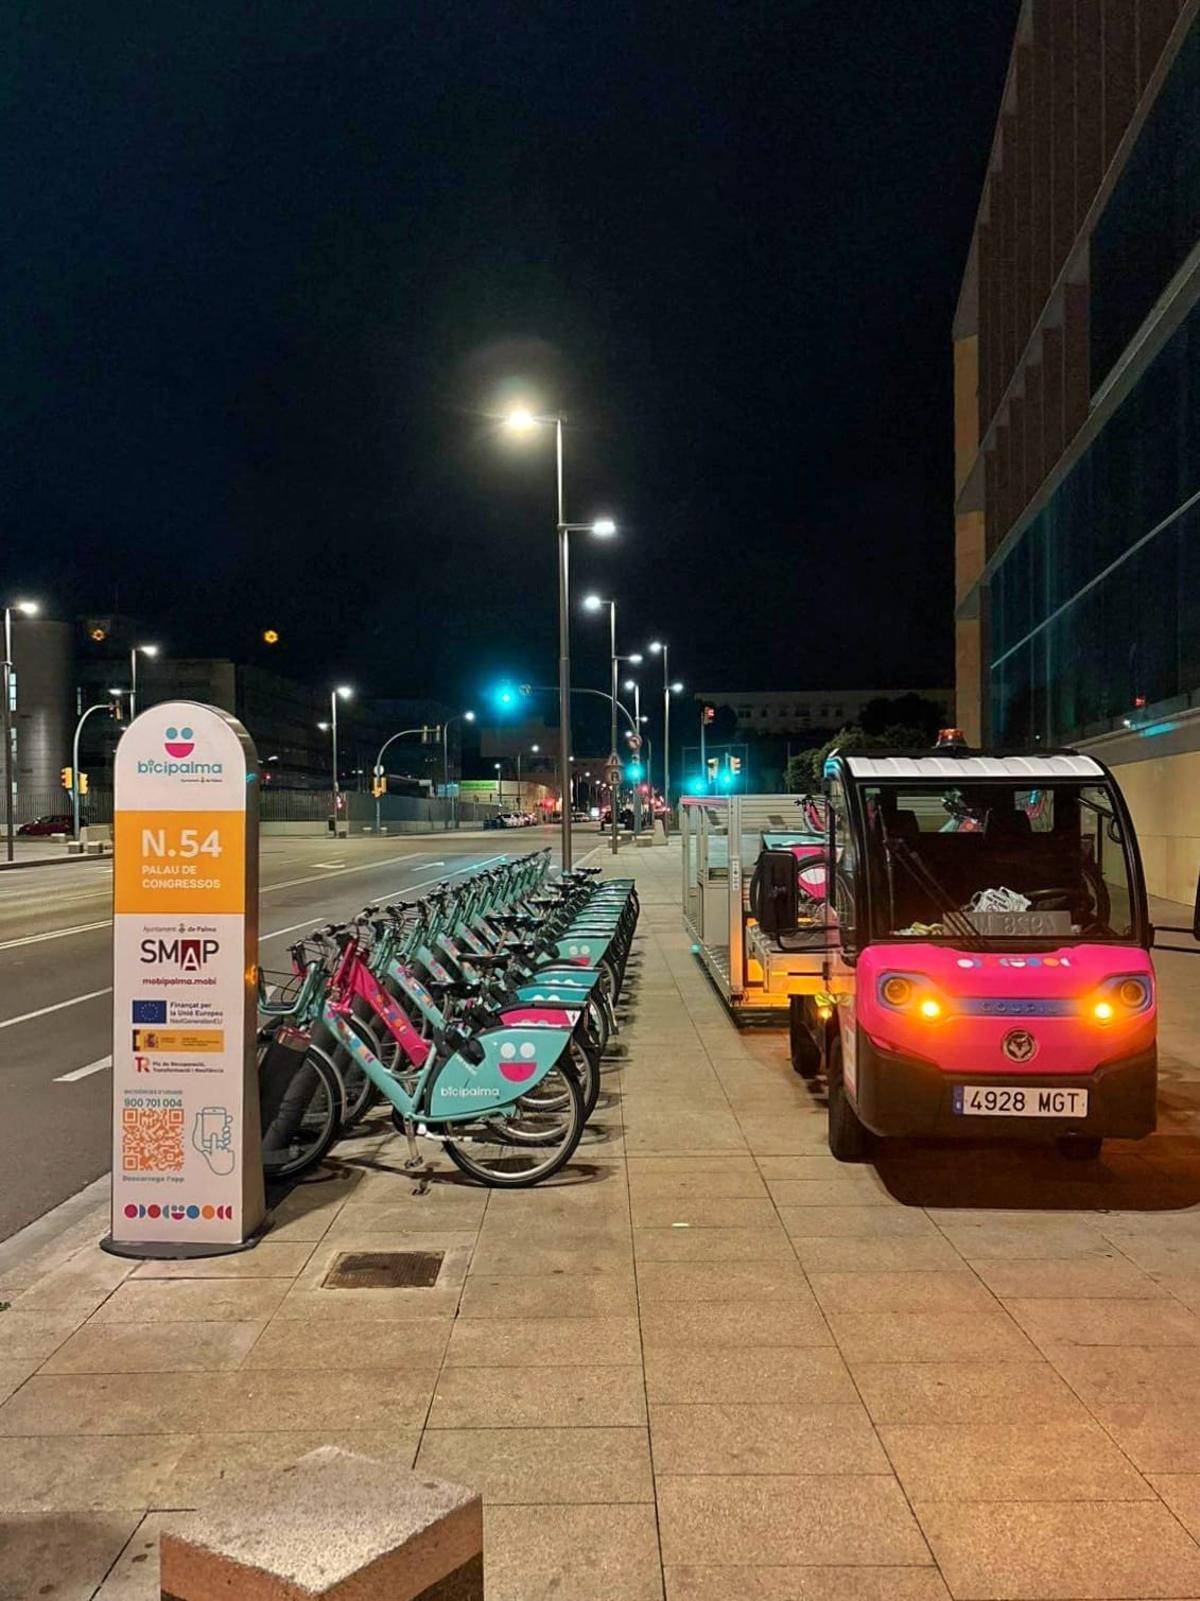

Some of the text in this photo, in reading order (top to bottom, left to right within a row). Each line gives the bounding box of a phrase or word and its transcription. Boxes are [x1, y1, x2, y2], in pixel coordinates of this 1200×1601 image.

[137, 759, 223, 776] bicipalma
[142, 829, 223, 858] N.54
[142, 865, 197, 875] PALAU DE
[142, 878, 221, 889] CONGRESSOS
[143, 926, 176, 934] Ajuntament
[140, 939, 219, 971] SMAP
[142, 977, 217, 988] mobipalma.mobi
[200, 1002, 212, 1010] per
[440, 1086, 500, 1097] bicipalma
[124, 1098, 183, 1108] 900 701 004
[970, 1090, 1080, 1113] 4928 MGT
